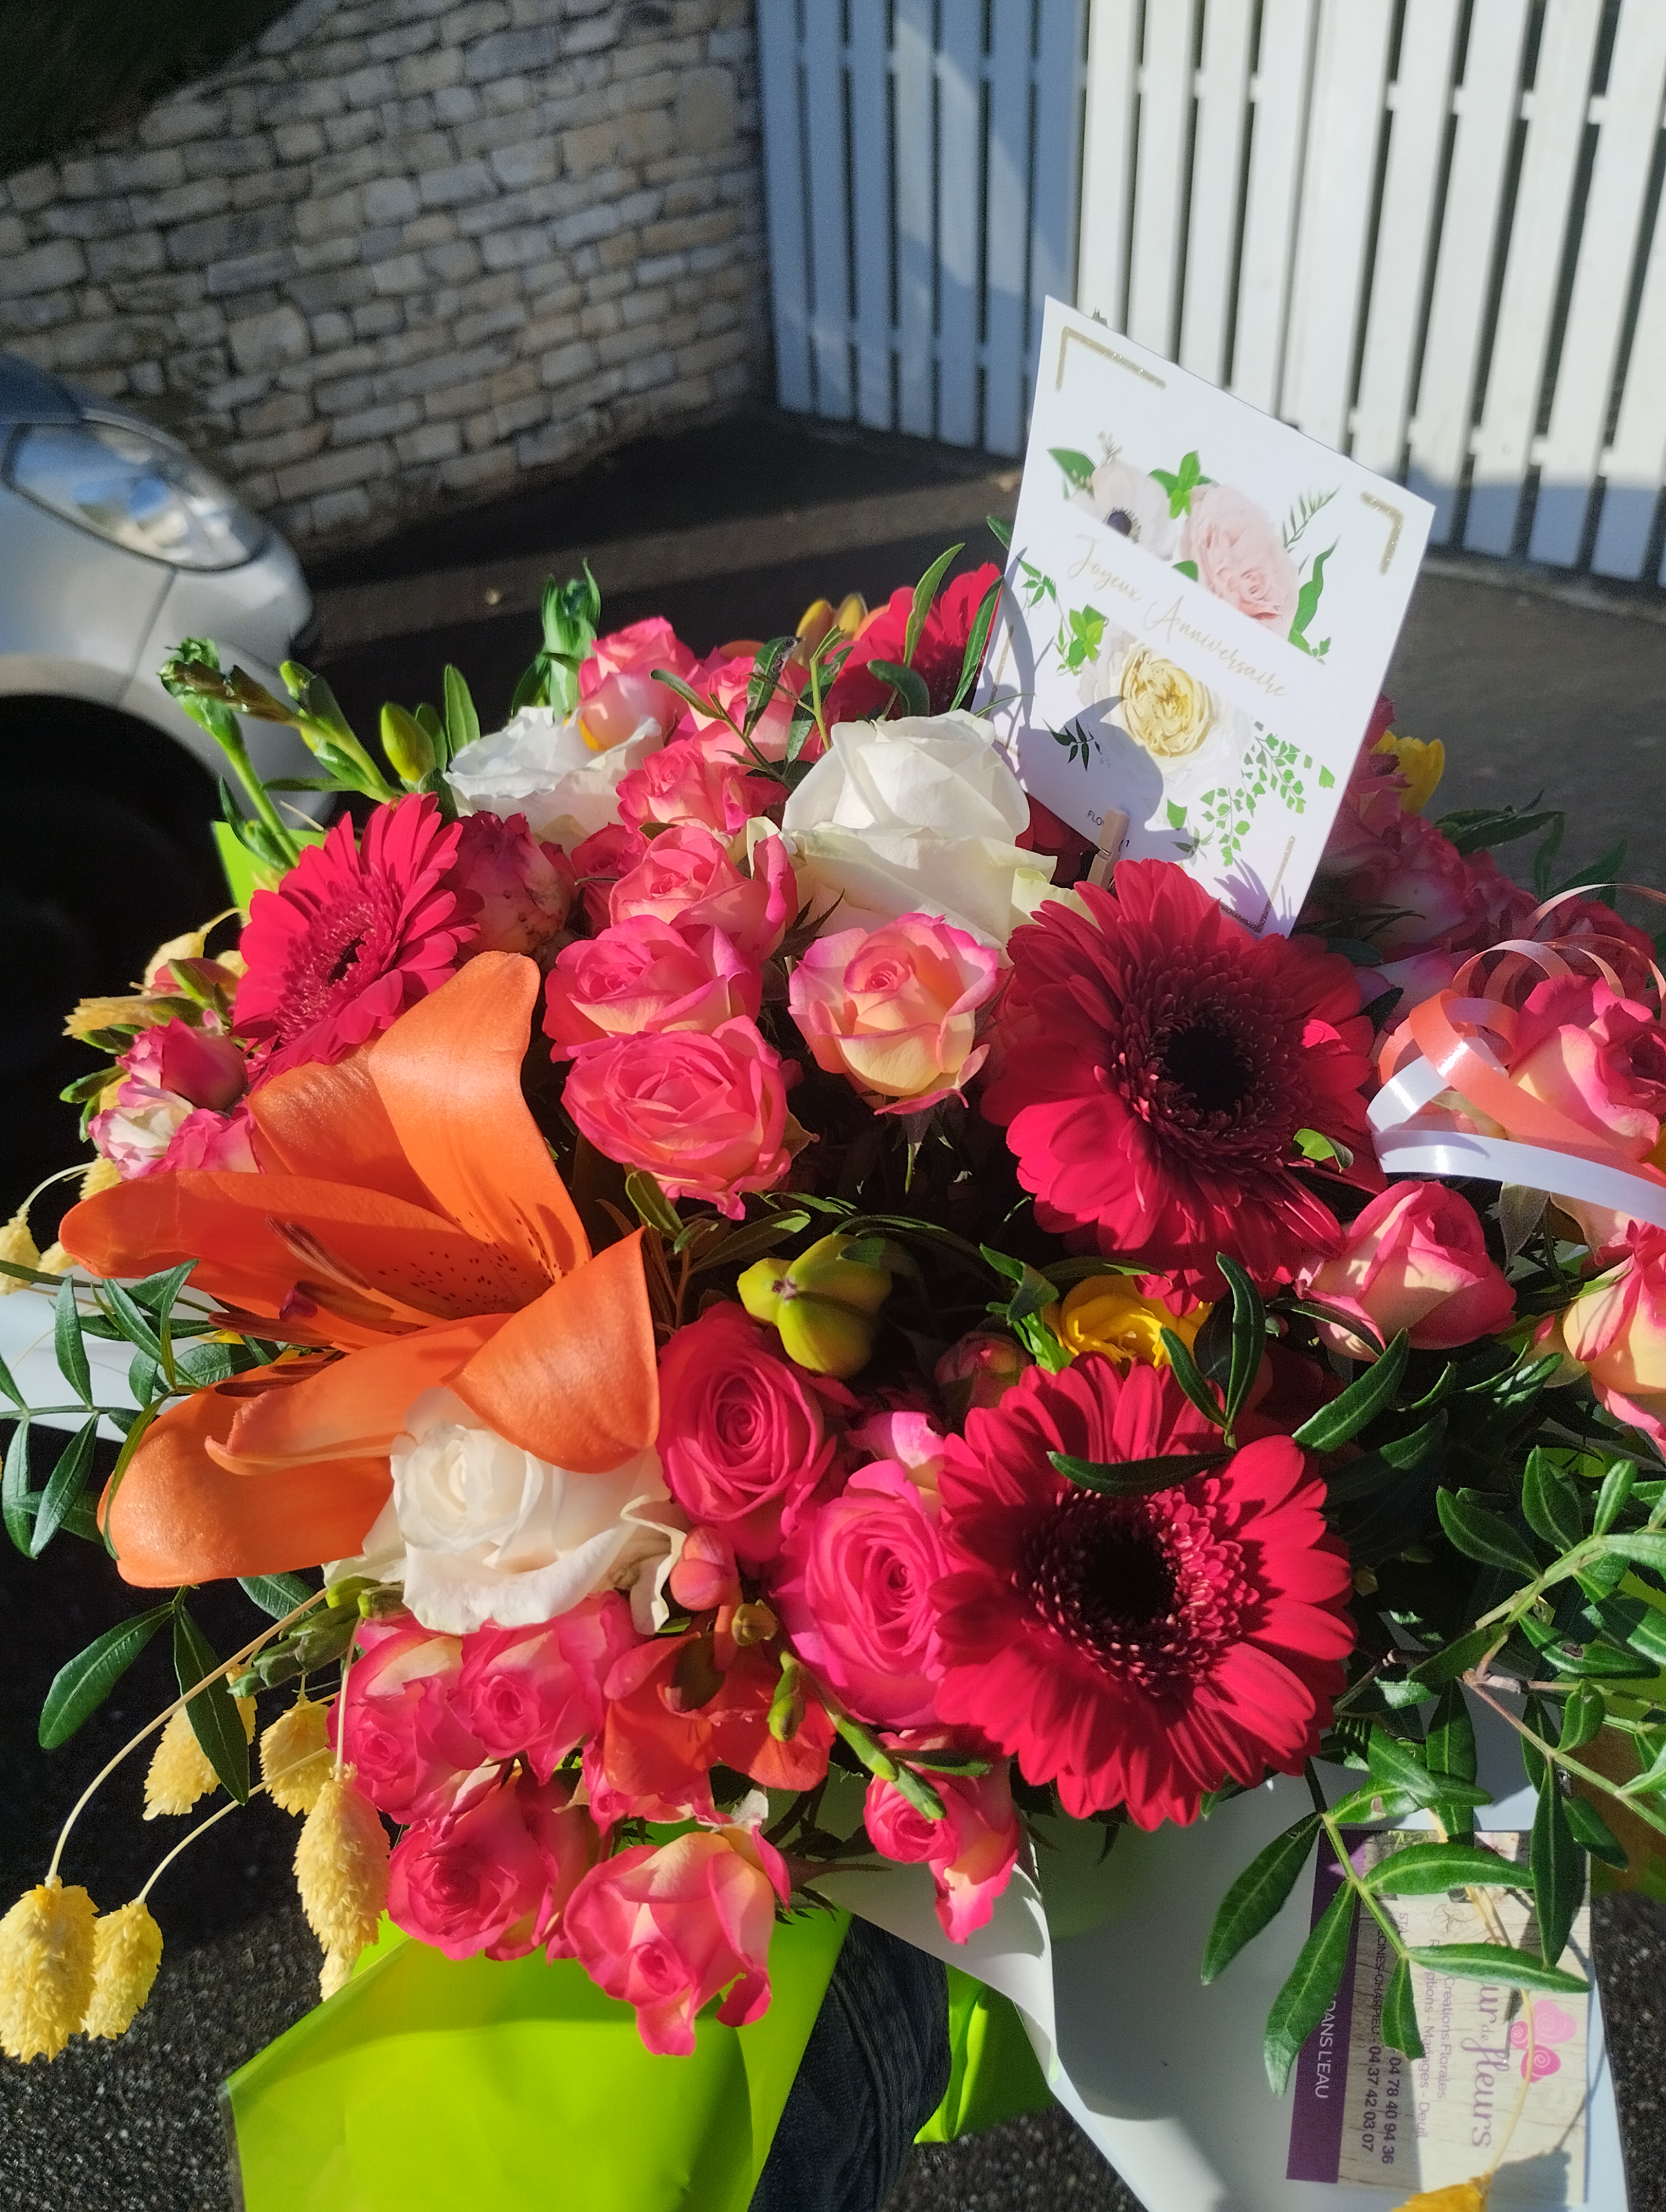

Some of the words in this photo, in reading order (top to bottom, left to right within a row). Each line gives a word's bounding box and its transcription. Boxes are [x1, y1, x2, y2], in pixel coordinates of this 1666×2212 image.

[1067, 533, 1143, 602] Joyeux
[1143, 594, 1287, 697] Anniversaire
[1481, 2024, 1494, 2042] de
[1369, 2046, 1381, 2063] 04
[1418, 2026, 1435, 2088] Mariages
[1315, 2051, 1332, 2099] L'EAU
[1389, 2057, 1401, 2075] 04
[1438, 2044, 1451, 2098] Florales
[1367, 2067, 1380, 2086] 37
[1387, 2079, 1399, 2097] 78
[1461, 2037, 1510, 2147] fleurs
[1365, 2089, 1377, 2107] 42
[1385, 2101, 1398, 2119] 40
[1363, 2111, 1376, 2130] 03
[1417, 2102, 1430, 2138] Deuil
[1384, 2123, 1396, 2140] 94
[1362, 2134, 1374, 2152] 07
[1382, 2145, 1394, 2164] 36
